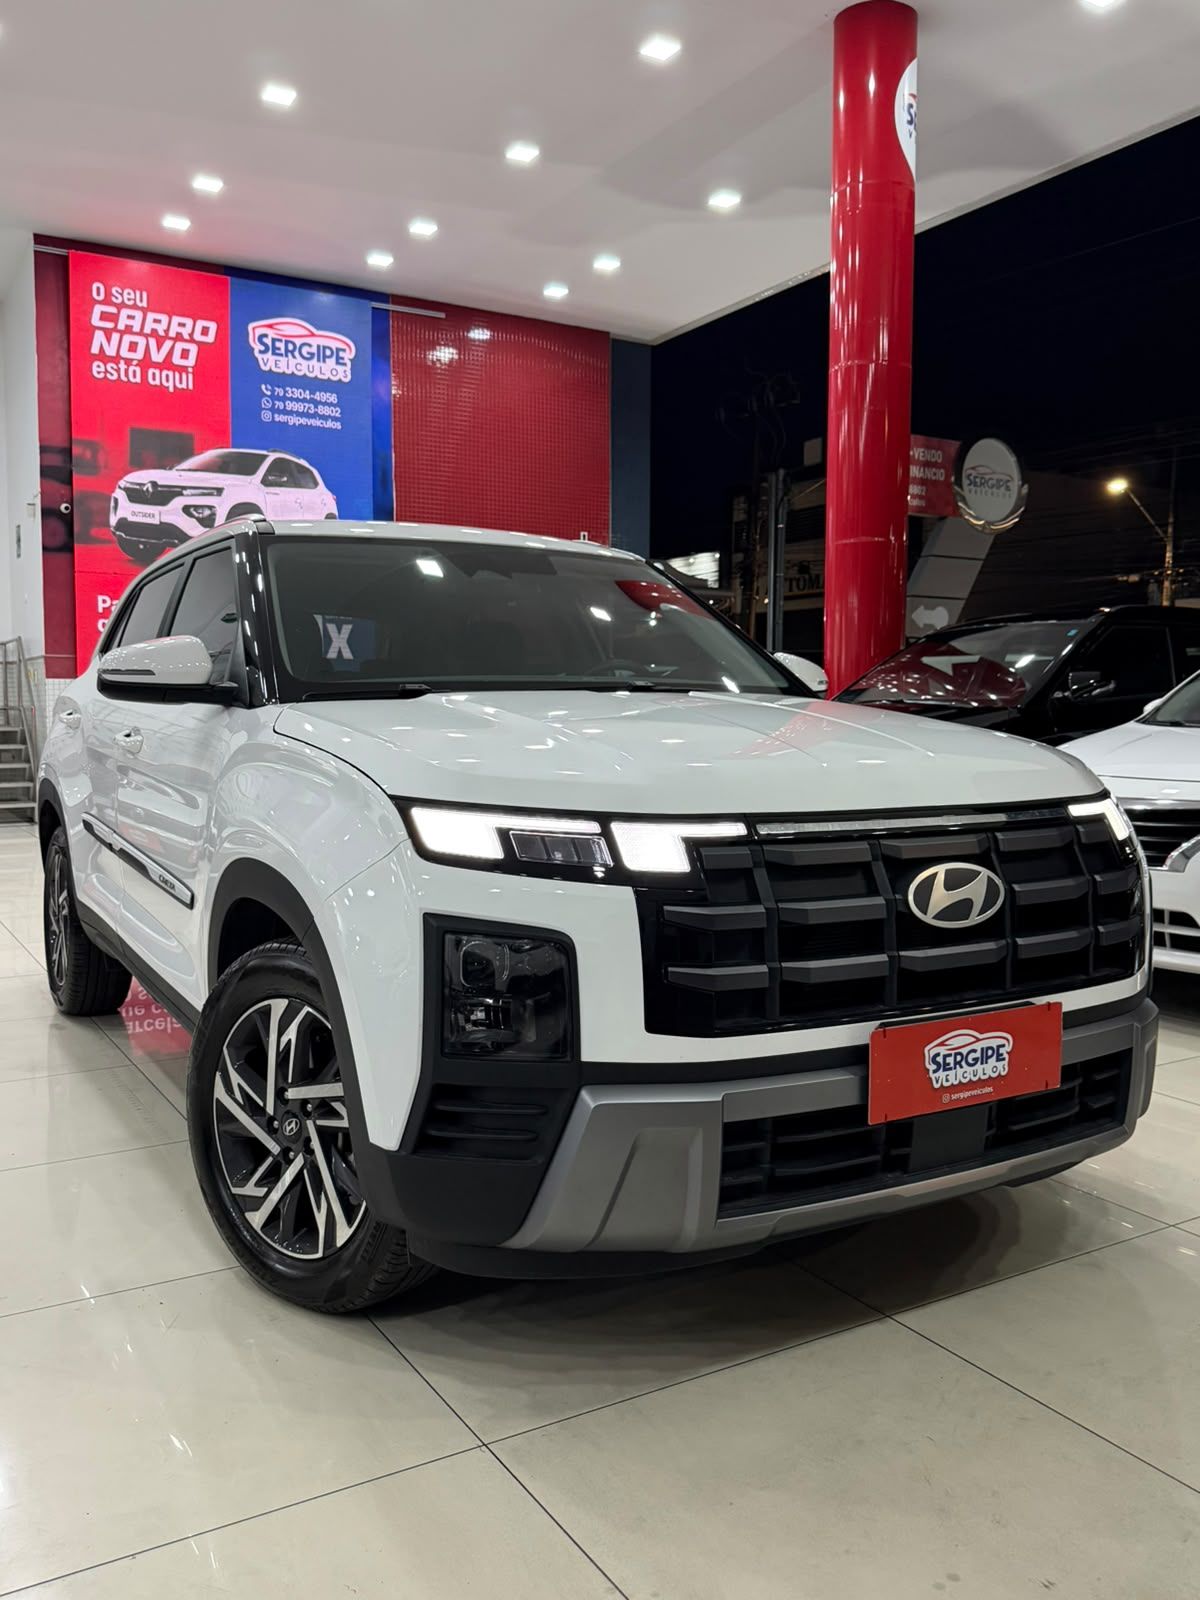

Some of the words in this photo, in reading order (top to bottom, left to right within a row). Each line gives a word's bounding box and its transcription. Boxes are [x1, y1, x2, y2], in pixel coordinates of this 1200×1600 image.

[91, 281, 105, 301] O
[111, 286, 148, 308] seu
[90, 303, 218, 344] CARRO
[90, 329, 199, 367] NOVO
[257, 333, 348, 367] SERGIPE
[91, 359, 142, 384] está
[147, 367, 194, 393] aqui
[285, 387, 338, 404] 3304-4956
[285, 400, 342, 417] 99973-8802
[273, 413, 342, 430] sergipeveiculos
[909, 465, 946, 481] INANCIO
[967, 473, 1011, 491] SERGIPE
[931, 1043, 1006, 1074] SERGIPE
[950, 1086, 994, 1100] sergipeveiculos
